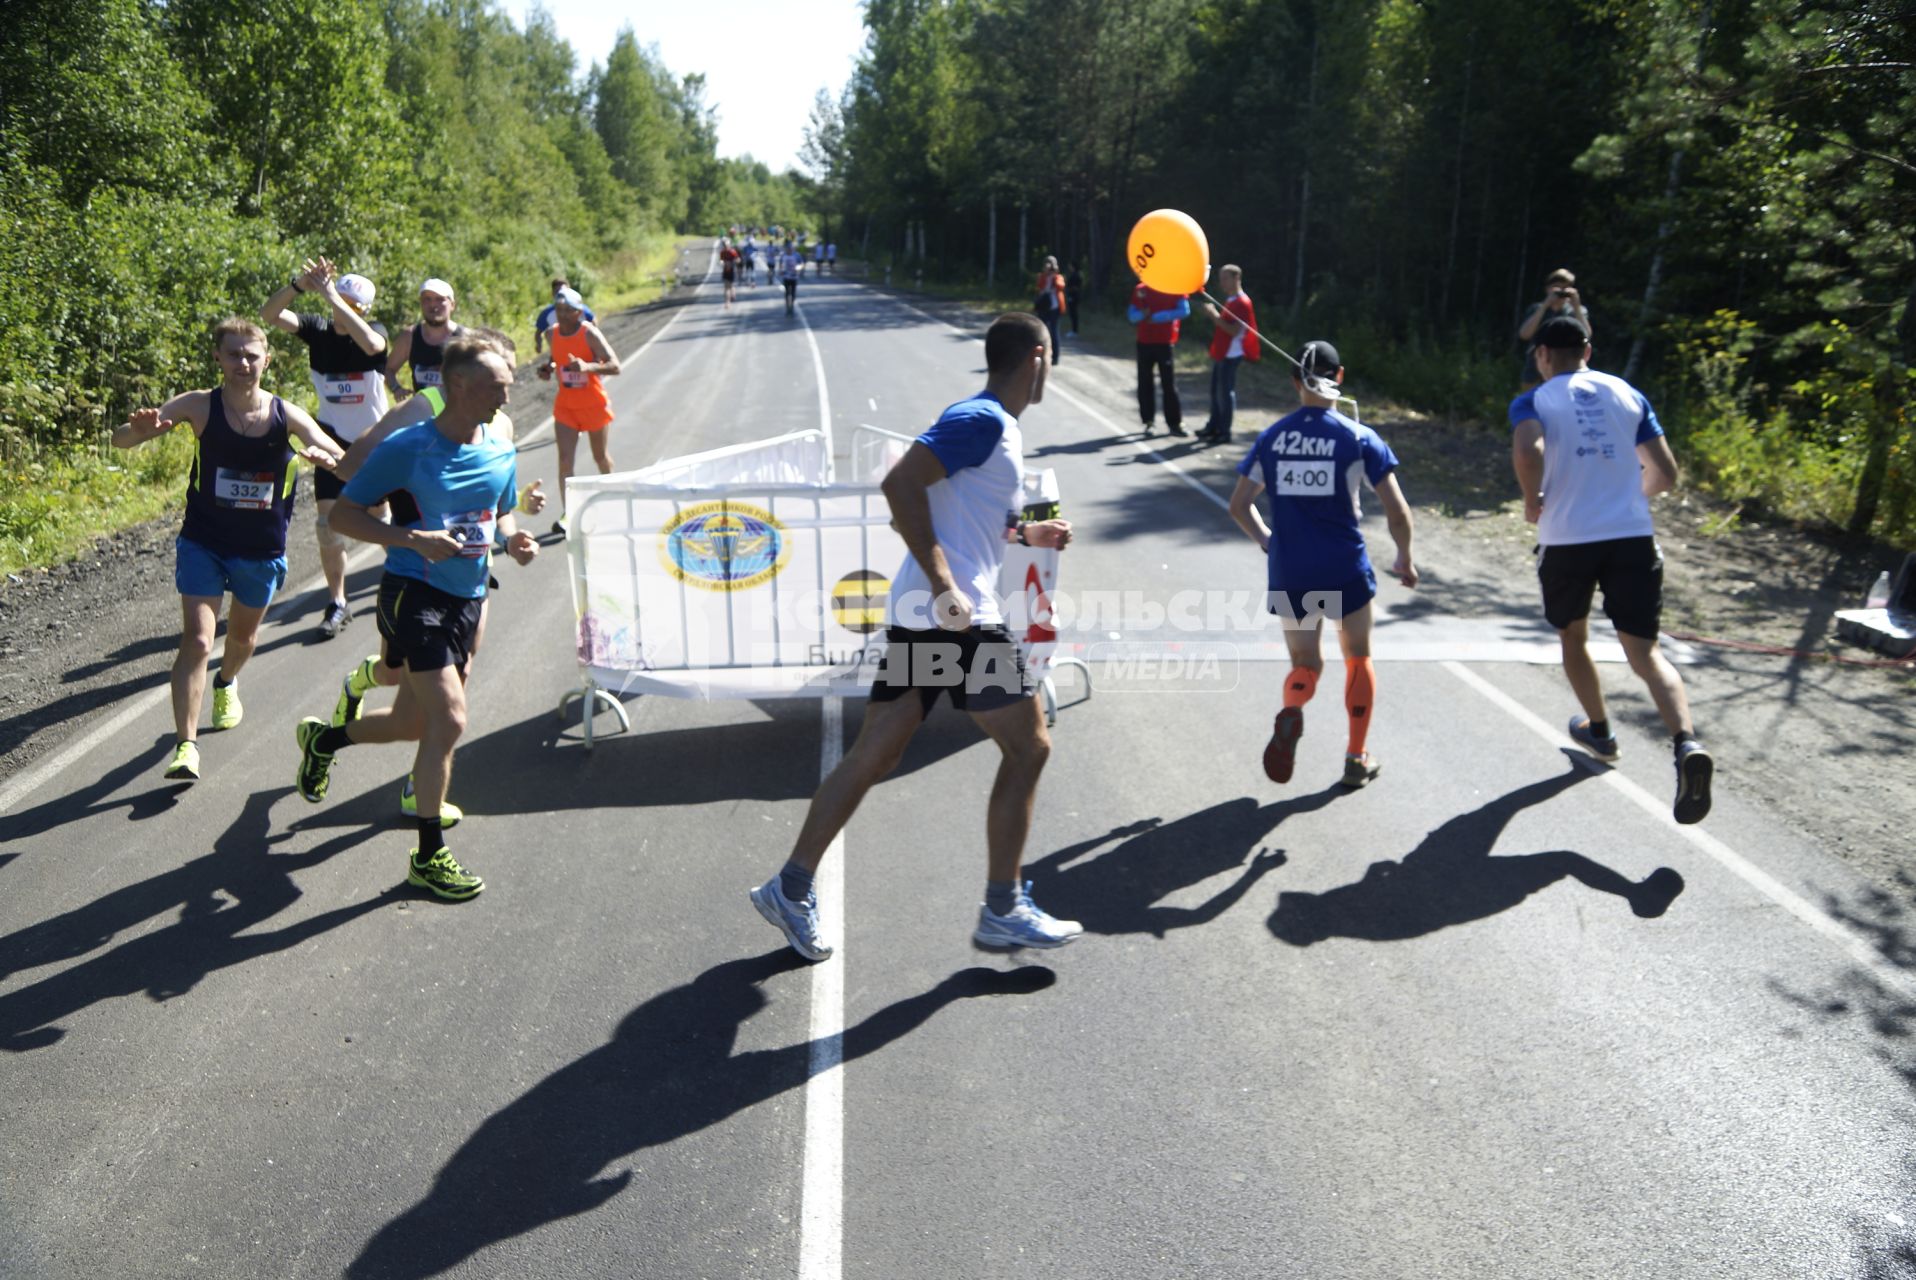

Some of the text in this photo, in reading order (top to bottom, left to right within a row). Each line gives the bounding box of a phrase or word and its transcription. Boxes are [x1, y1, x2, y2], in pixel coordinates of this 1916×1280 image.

[337, 383, 352, 394] 90
[1283, 469, 1329, 487] 4:00
[230, 483, 259, 498] 332
[467, 526, 485, 541] 28
[808, 644, 884, 666] Била
